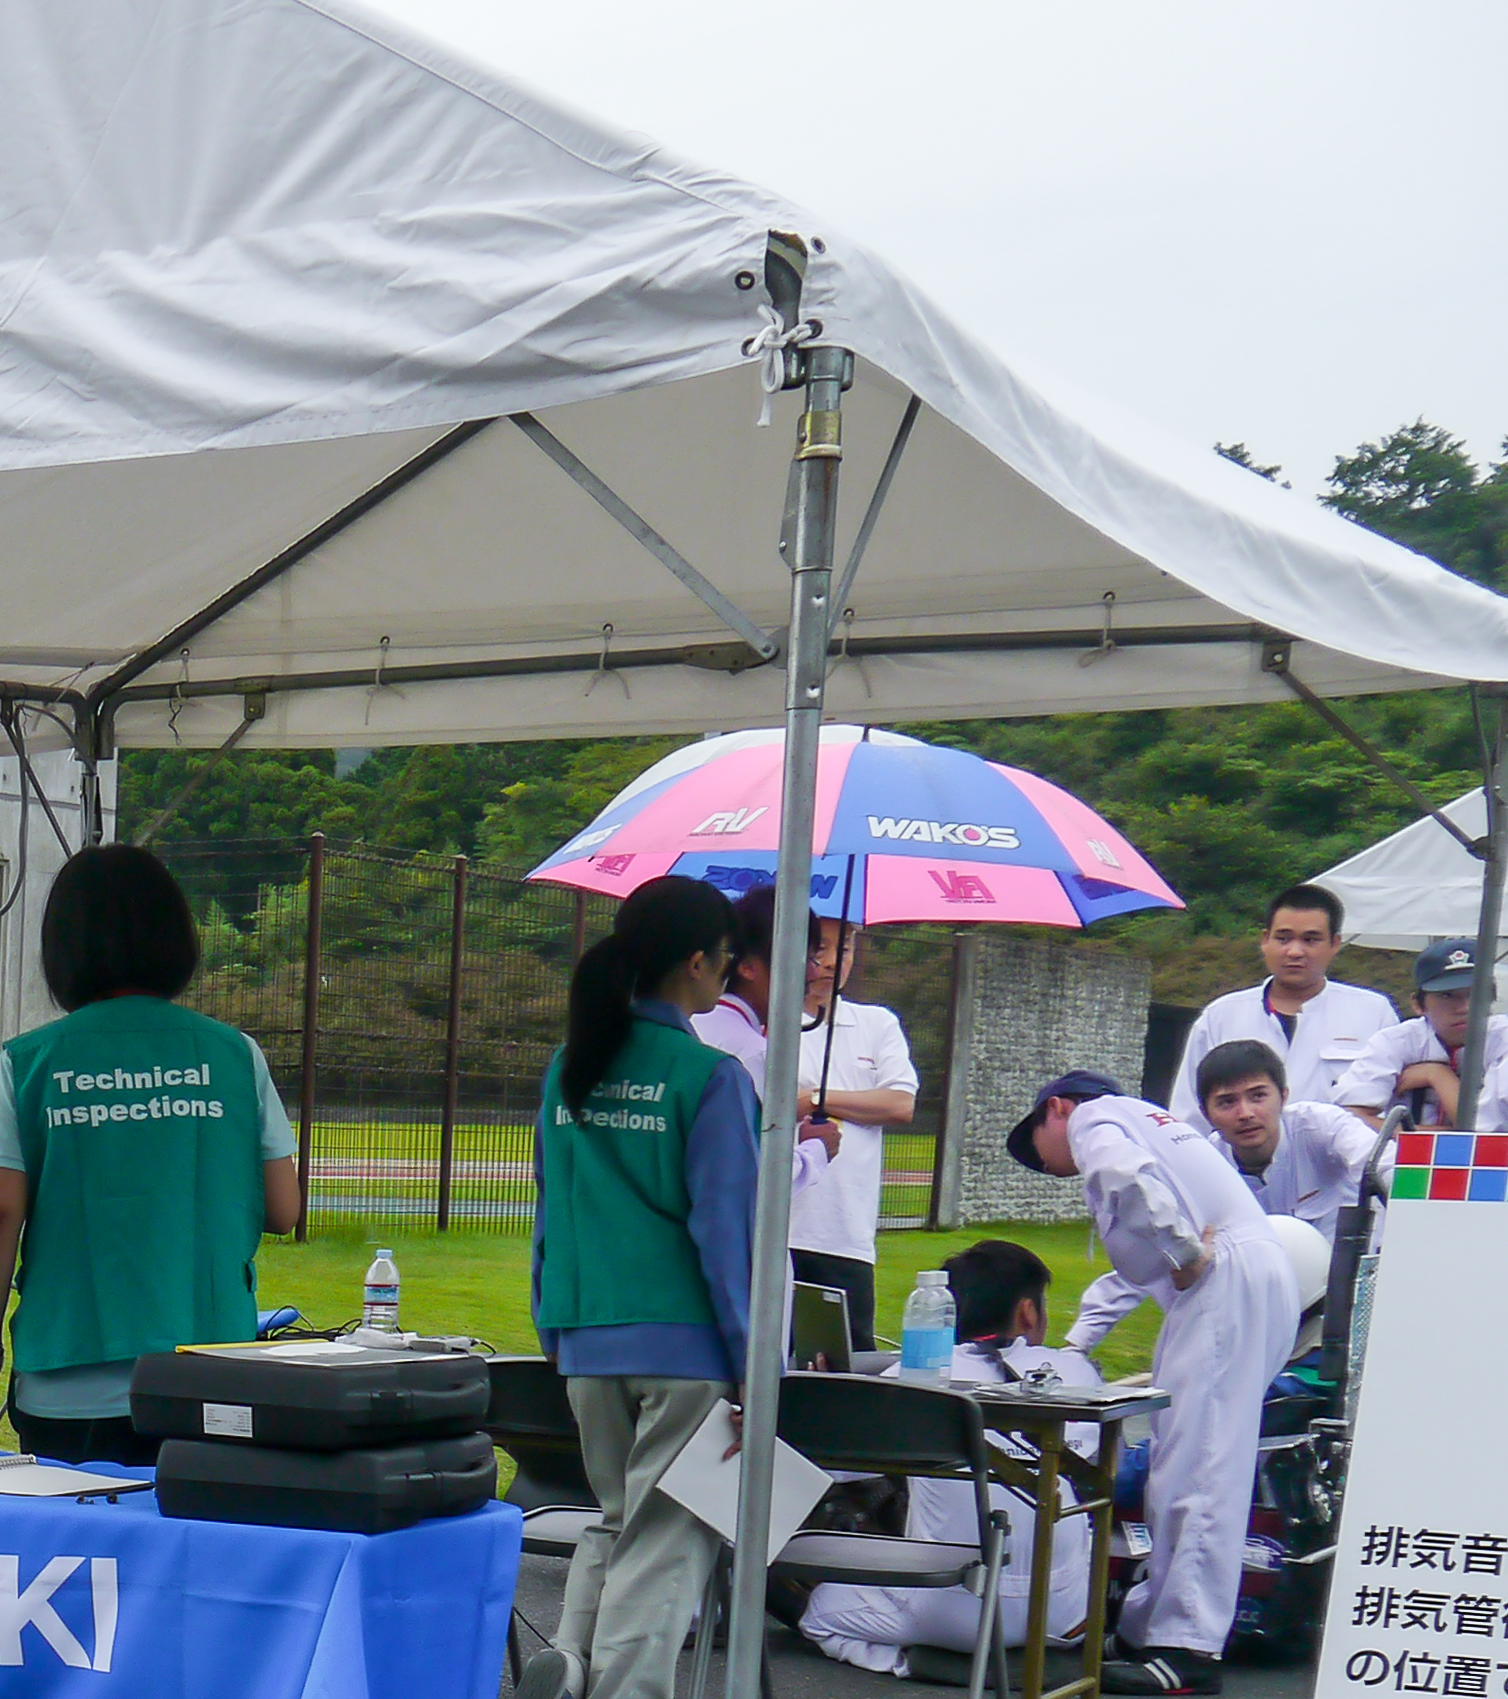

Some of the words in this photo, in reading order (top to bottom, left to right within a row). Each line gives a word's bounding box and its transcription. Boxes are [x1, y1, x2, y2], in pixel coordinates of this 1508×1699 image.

[866, 815, 1021, 850] WAKO'S
[53, 1064, 210, 1093] Technical
[46, 1095, 224, 1129] Inspections
[555, 1105, 668, 1132] Inpections
[1361, 1525, 1508, 1576] 排気音
[1352, 1585, 1508, 1639] 排気管
